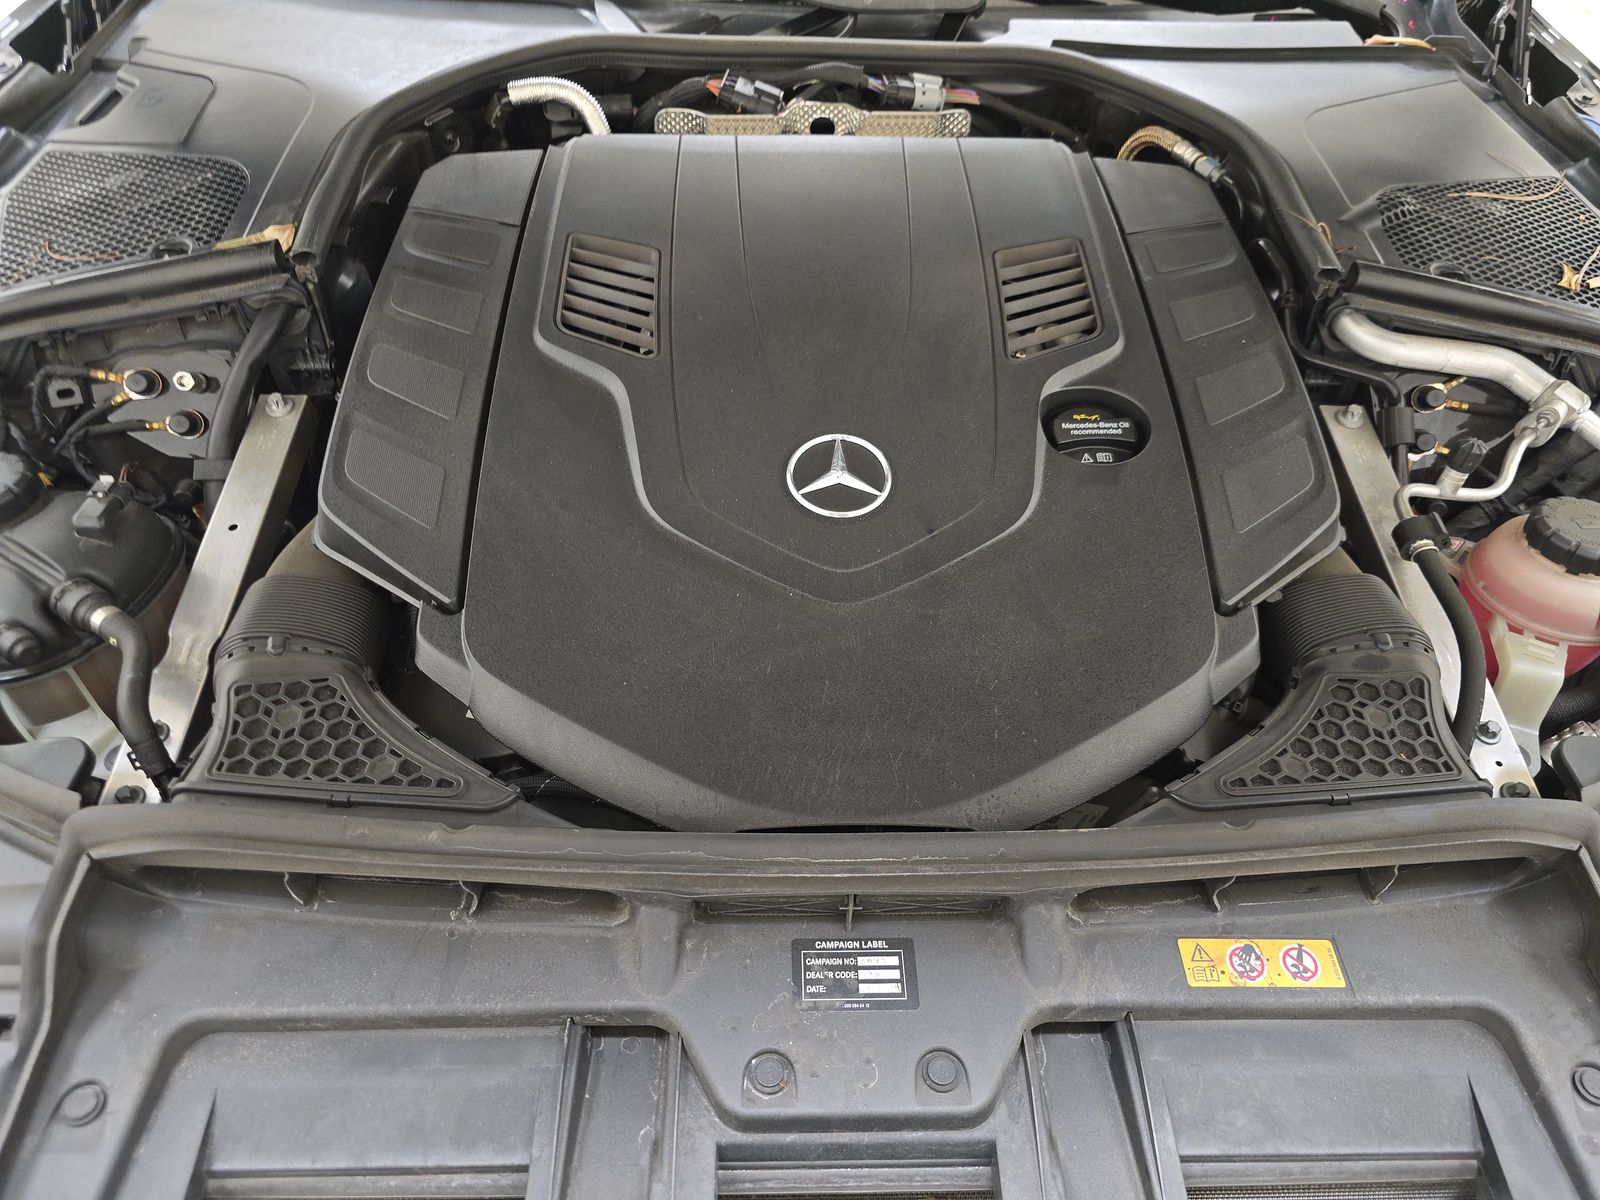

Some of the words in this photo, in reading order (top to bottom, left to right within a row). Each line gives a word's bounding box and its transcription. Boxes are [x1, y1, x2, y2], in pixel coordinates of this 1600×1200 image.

[815, 941, 860, 949] CAMPAIGN
[861, 940, 889, 948] LABEL
[805, 957, 843, 965] CAMPAIGN
[843, 957, 857, 965] NO:
[835, 971, 858, 979] CODE:
[806, 985, 827, 993] DATE:
